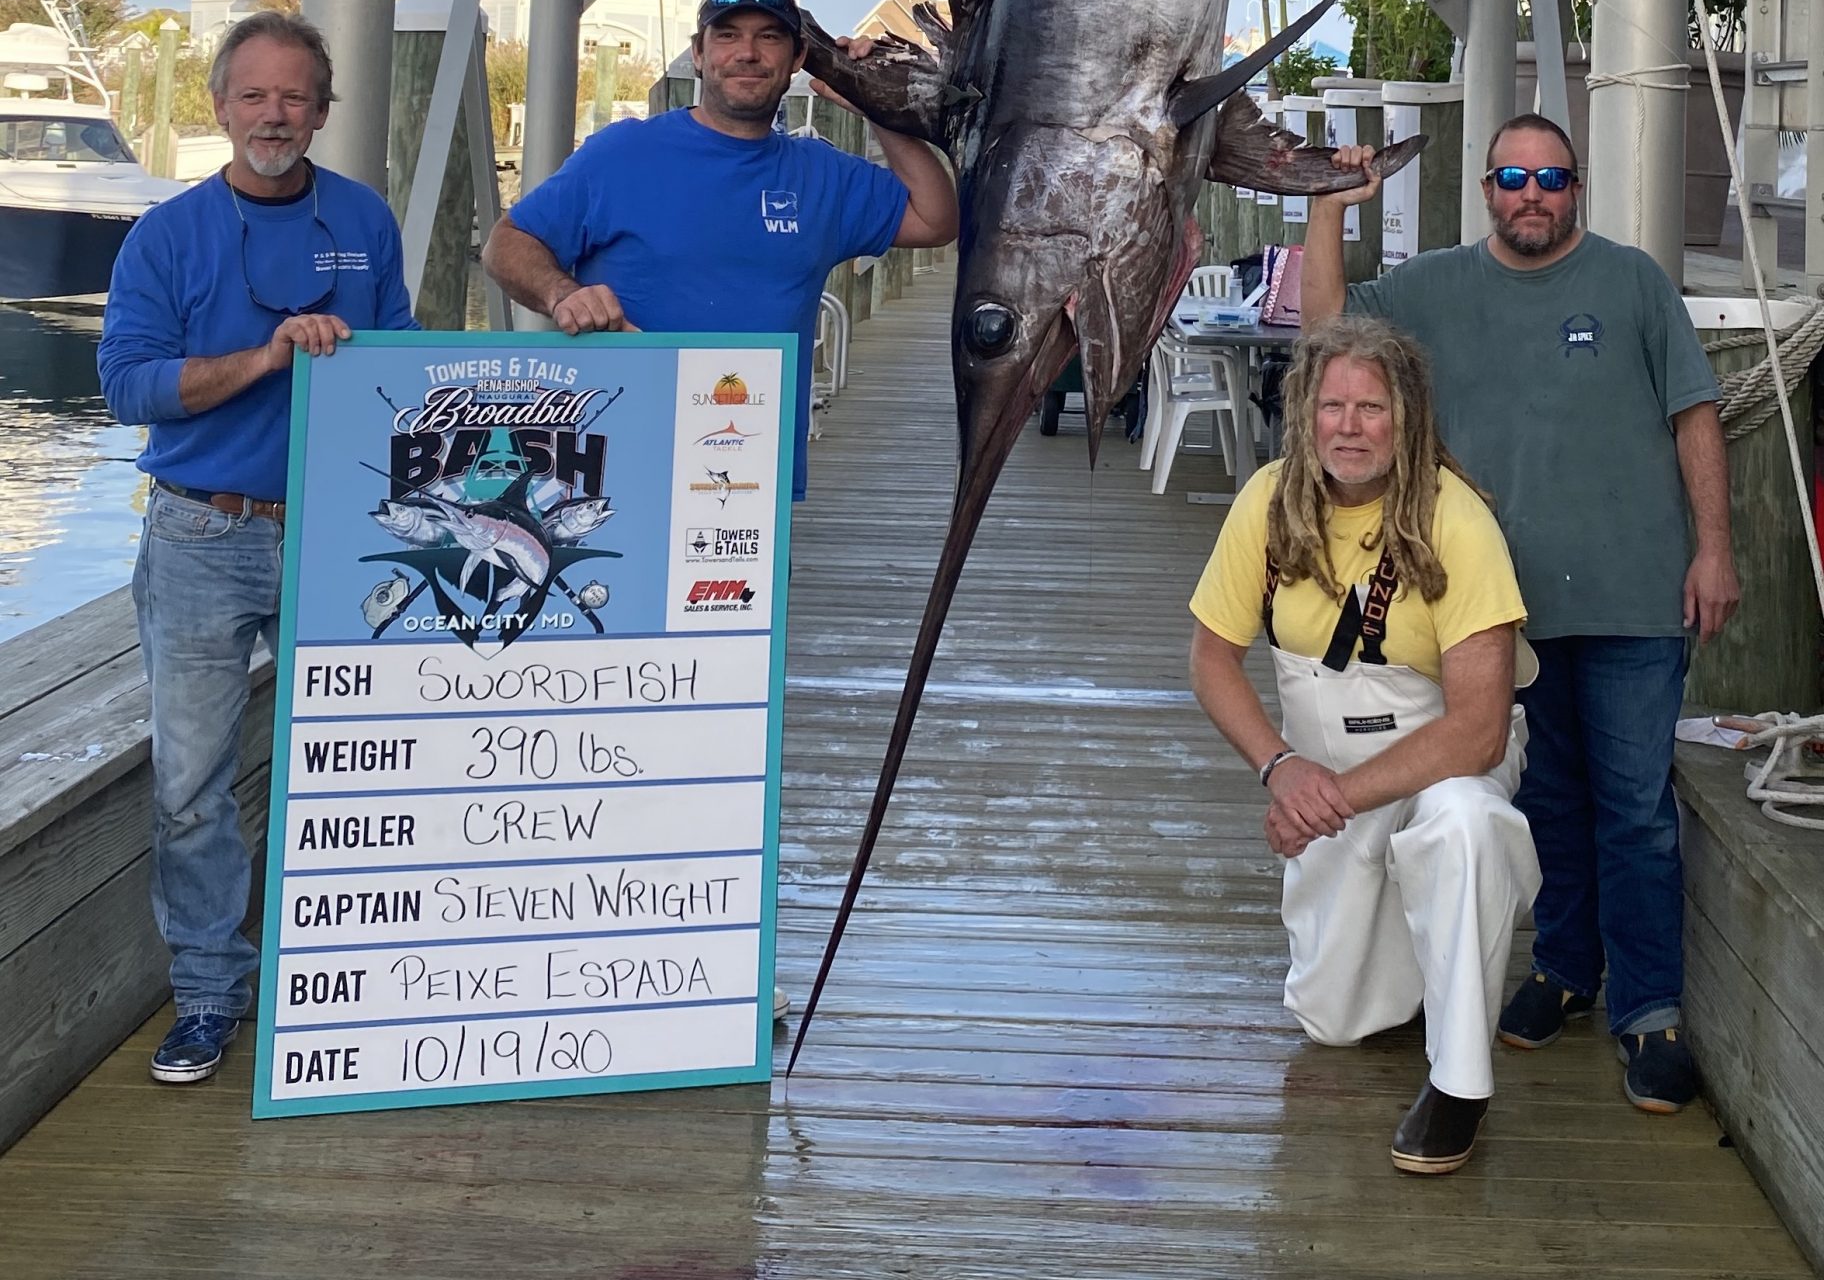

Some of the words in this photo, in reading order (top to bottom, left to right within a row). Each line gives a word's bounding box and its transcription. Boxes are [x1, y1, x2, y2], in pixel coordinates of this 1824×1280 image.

[764, 219, 799, 234] WLM
[424, 359, 502, 385] TOWERS
[509, 357, 521, 378] &
[527, 358, 578, 386] TAILS
[477, 379, 502, 393] RENA
[504, 378, 540, 392] BISHOP
[393, 385, 608, 438] Broadbill
[391, 427, 608, 499] BASH
[715, 528, 759, 541] TOWERS
[684, 605, 704, 613] SALES
[704, 604, 709, 612] &
[686, 580, 748, 601] EMM
[403, 615, 476, 632] OCEAN
[481, 613, 535, 631] CITY,
[541, 613, 575, 630] MD
[306, 664, 372, 697] FISH
[418, 656, 698, 704] SWORDFISH
[304, 738, 417, 774] WEIGHT
[466, 725, 558, 780] 390
[579, 730, 644, 777] lbs.
[299, 814, 415, 851] ANGLER
[463, 798, 604, 846] CREW
[294, 890, 421, 928] CAPTAIN
[433, 876, 575, 924] STEVEN
[586, 867, 740, 922] WRIGHT
[289, 969, 367, 1007] BOAT
[390, 953, 518, 1002] PEIXE
[546, 949, 713, 1000] ESPADA
[285, 1047, 360, 1085] DATE
[401, 1020, 612, 1083] 10/19/20
